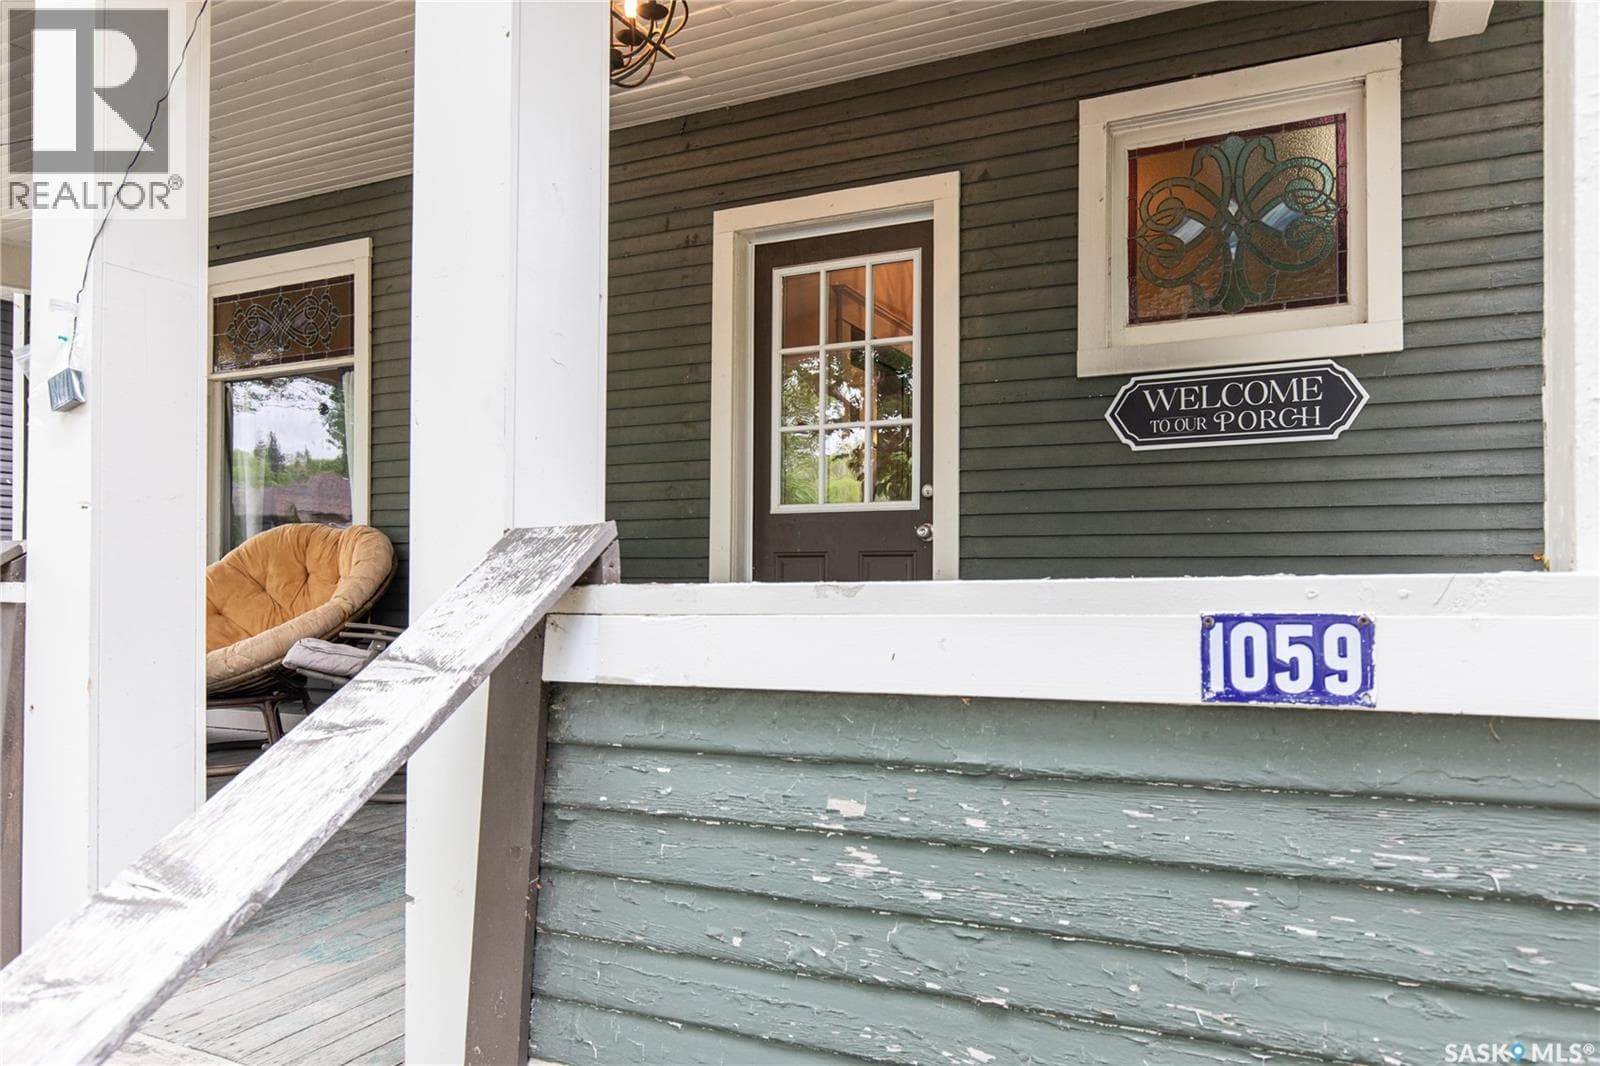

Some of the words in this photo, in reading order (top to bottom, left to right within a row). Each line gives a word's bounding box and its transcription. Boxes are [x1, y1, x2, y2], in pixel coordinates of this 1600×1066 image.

[1142, 375, 1323, 413] WELCOME
[1150, 420, 1171, 433] TO
[1174, 416, 1207, 431] OUR
[1213, 405, 1321, 432] PORCH
[1209, 621, 1363, 697] 1059
